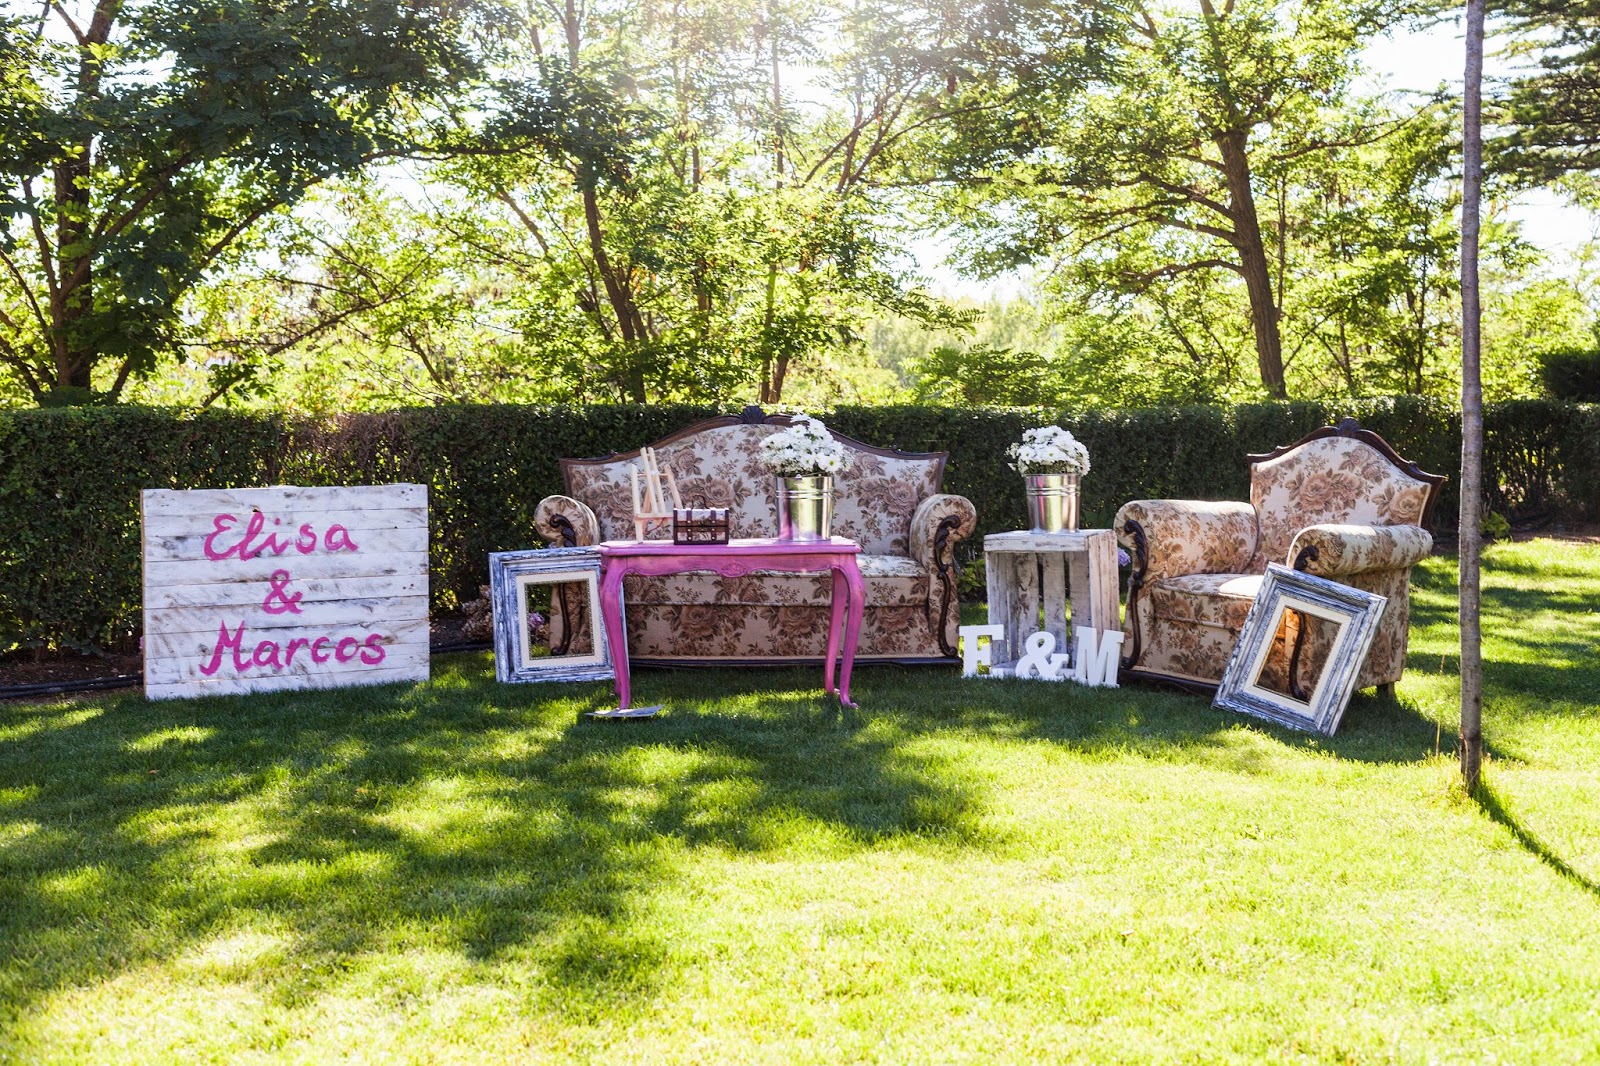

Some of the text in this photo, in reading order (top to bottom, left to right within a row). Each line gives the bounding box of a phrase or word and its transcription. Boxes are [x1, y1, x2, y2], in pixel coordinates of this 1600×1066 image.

[203, 511, 359, 562] Elisa
[262, 569, 304, 615] &
[199, 620, 386, 676] Marcos
[959, 624, 1124, 688] E & M
